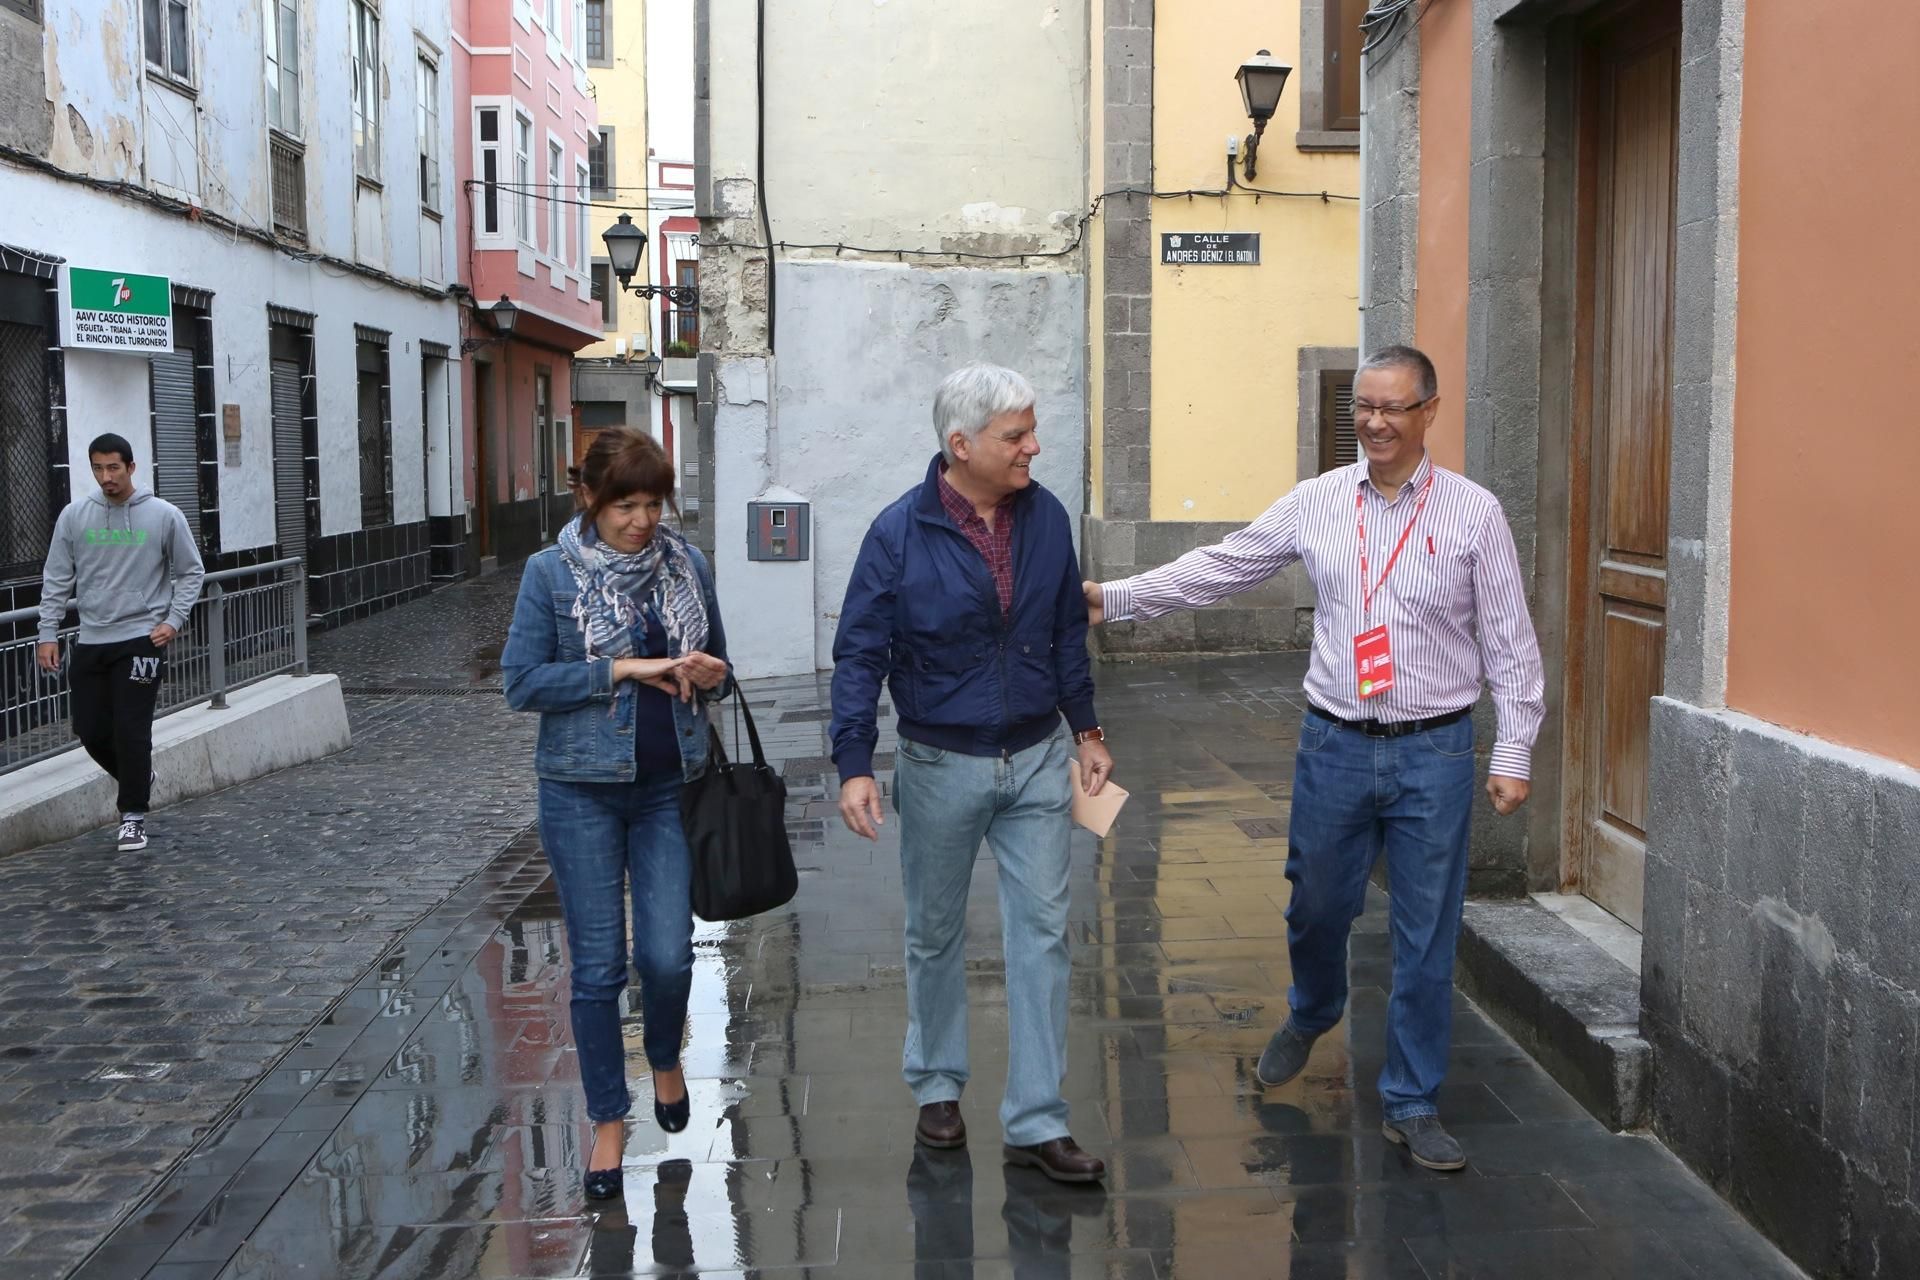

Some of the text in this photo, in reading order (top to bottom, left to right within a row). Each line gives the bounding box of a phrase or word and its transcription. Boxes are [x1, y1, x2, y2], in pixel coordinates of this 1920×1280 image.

[1194, 235, 1230, 243] CALLE
[76, 311, 167, 327] AAVV CASCO HISTORICO
[76, 324, 104, 333] VEGUETA
[110, 326, 132, 335] TRIANA
[138, 327, 146, 335] LA
[147, 328, 167, 337] UNION
[76, 334, 168, 347] EL RINCON DEL TURRONERO
[130, 656, 160, 678] NY
